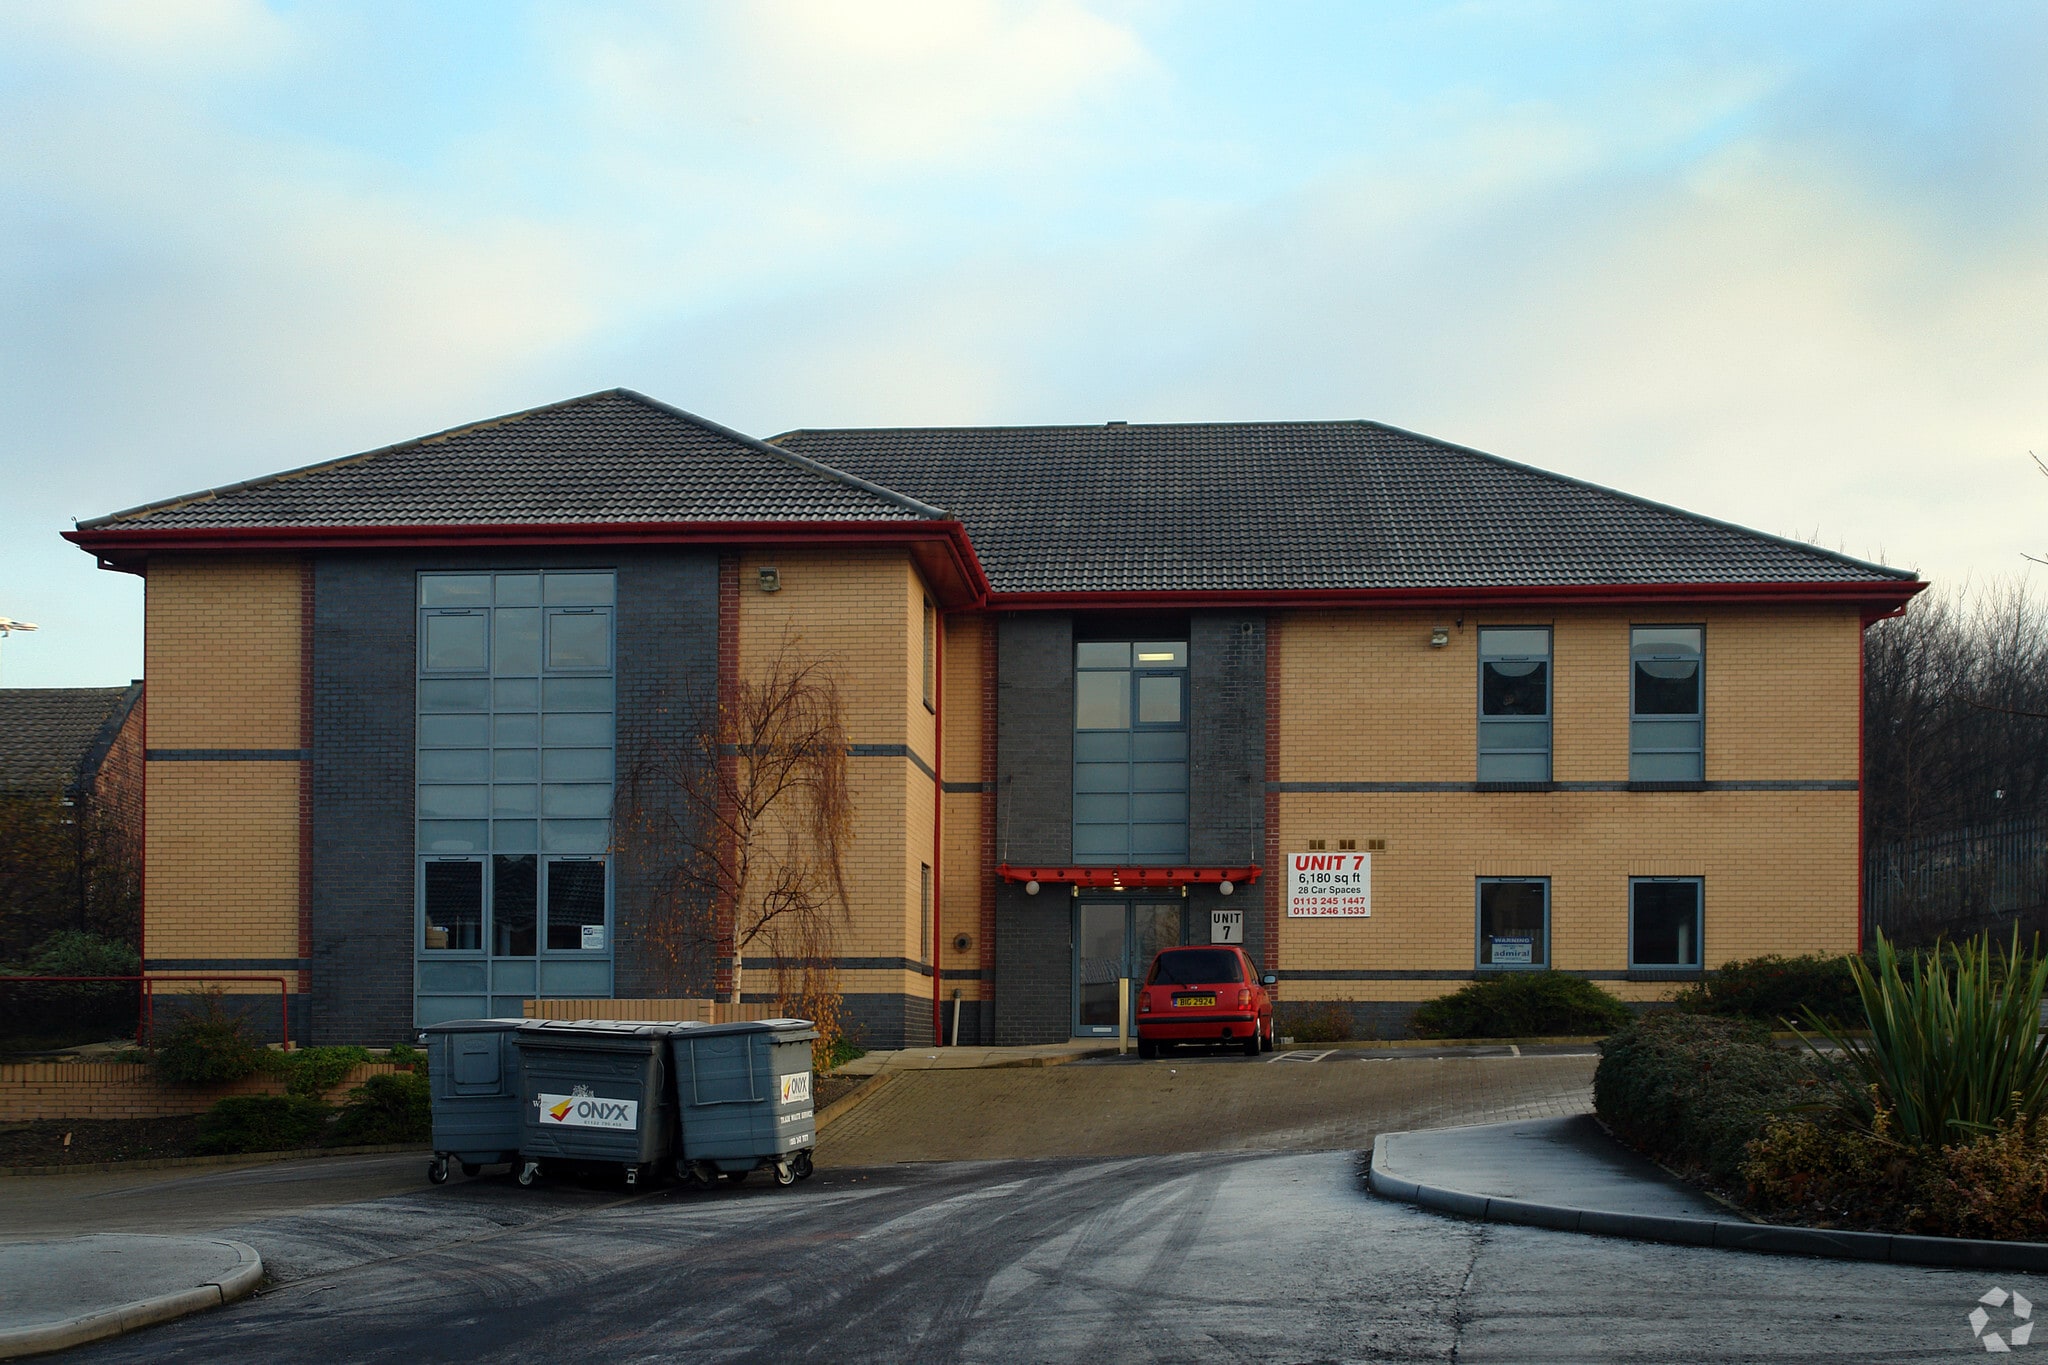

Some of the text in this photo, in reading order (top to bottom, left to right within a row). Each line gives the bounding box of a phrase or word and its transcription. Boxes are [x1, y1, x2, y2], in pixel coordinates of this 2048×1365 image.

[1295, 855, 1364, 871] UNIT 7
[1299, 872, 1360, 885] 6,180 sq ft
[1298, 886, 1361, 895] 28 Car Spaces
[1293, 897, 1365, 905] 0113 245 1447
[1293, 907, 1365, 915] 0113 246 1533
[1213, 913, 1241, 940] UNIT 7
[791, 1077, 807, 1094] ONYX
[577, 1101, 629, 1121] ONYX
